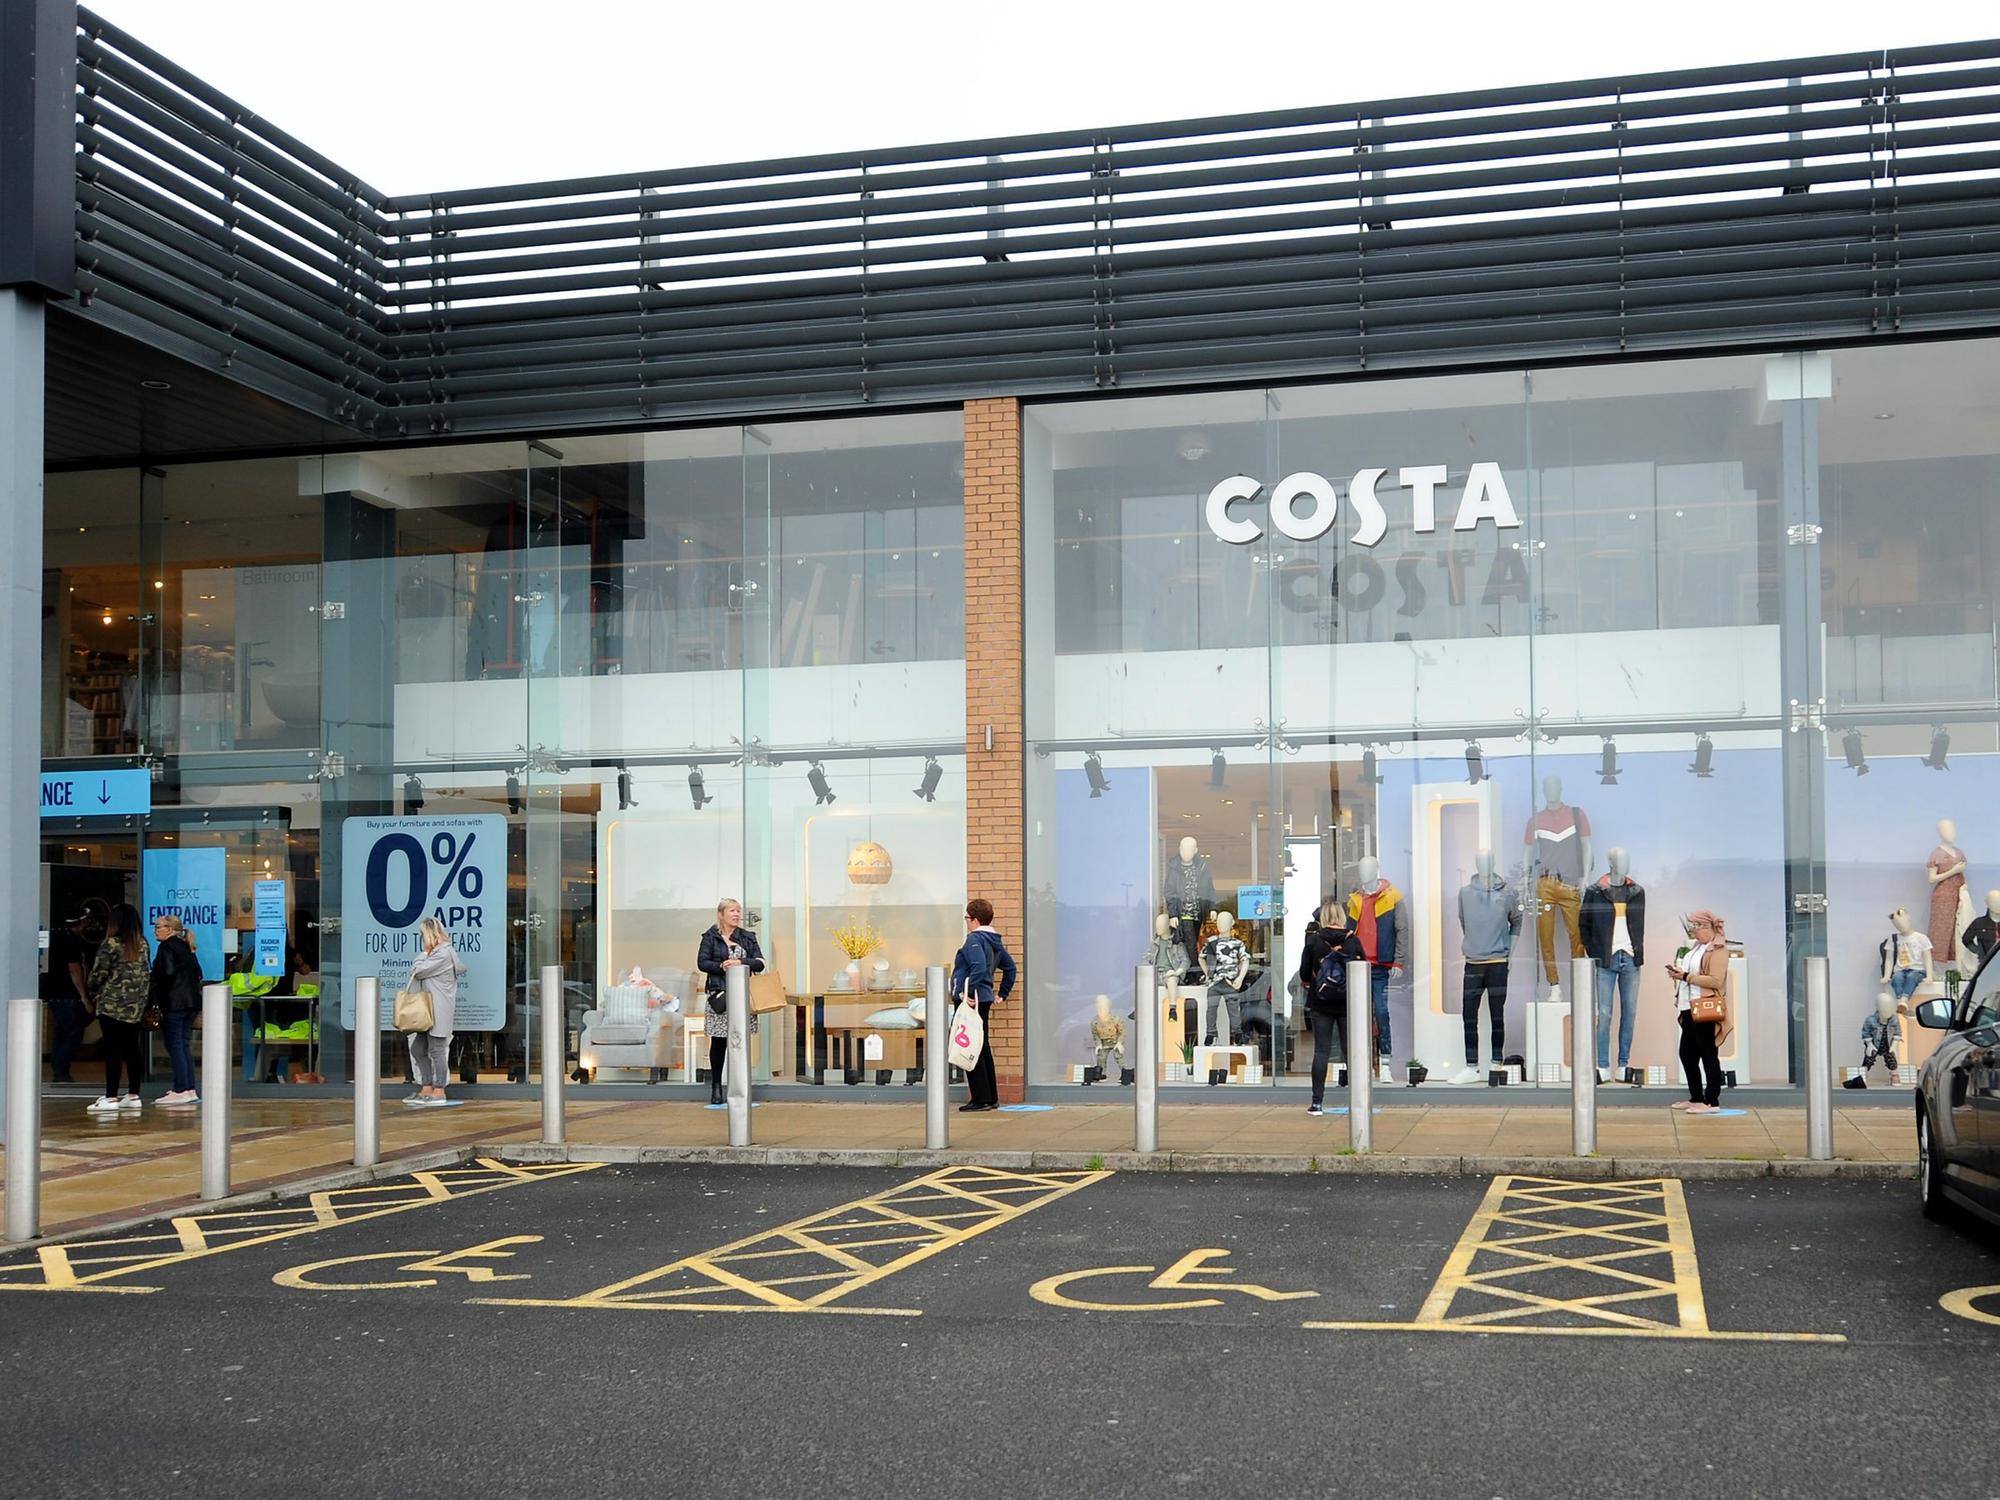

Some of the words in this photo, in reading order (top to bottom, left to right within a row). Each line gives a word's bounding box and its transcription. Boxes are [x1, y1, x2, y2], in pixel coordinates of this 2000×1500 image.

[1205, 462, 1521, 549] COSTA
[242, 569, 314, 585] Bathroom
[1280, 547, 1532, 618] COSTA
[40, 781, 73, 806] NCE
[366, 820, 380, 829] Buy
[381, 821, 397, 829] your
[399, 820, 430, 828] furniture
[431, 819, 445, 827] and
[446, 819, 465, 827] sofas
[365, 832, 483, 929] 0%
[167, 888, 199, 900] next
[433, 906, 483, 928] APR
[365, 933, 387, 953] FOR
[393, 933, 408, 952] UP
[449, 932, 481, 952] EARS
[382, 959, 413, 967] Minim
